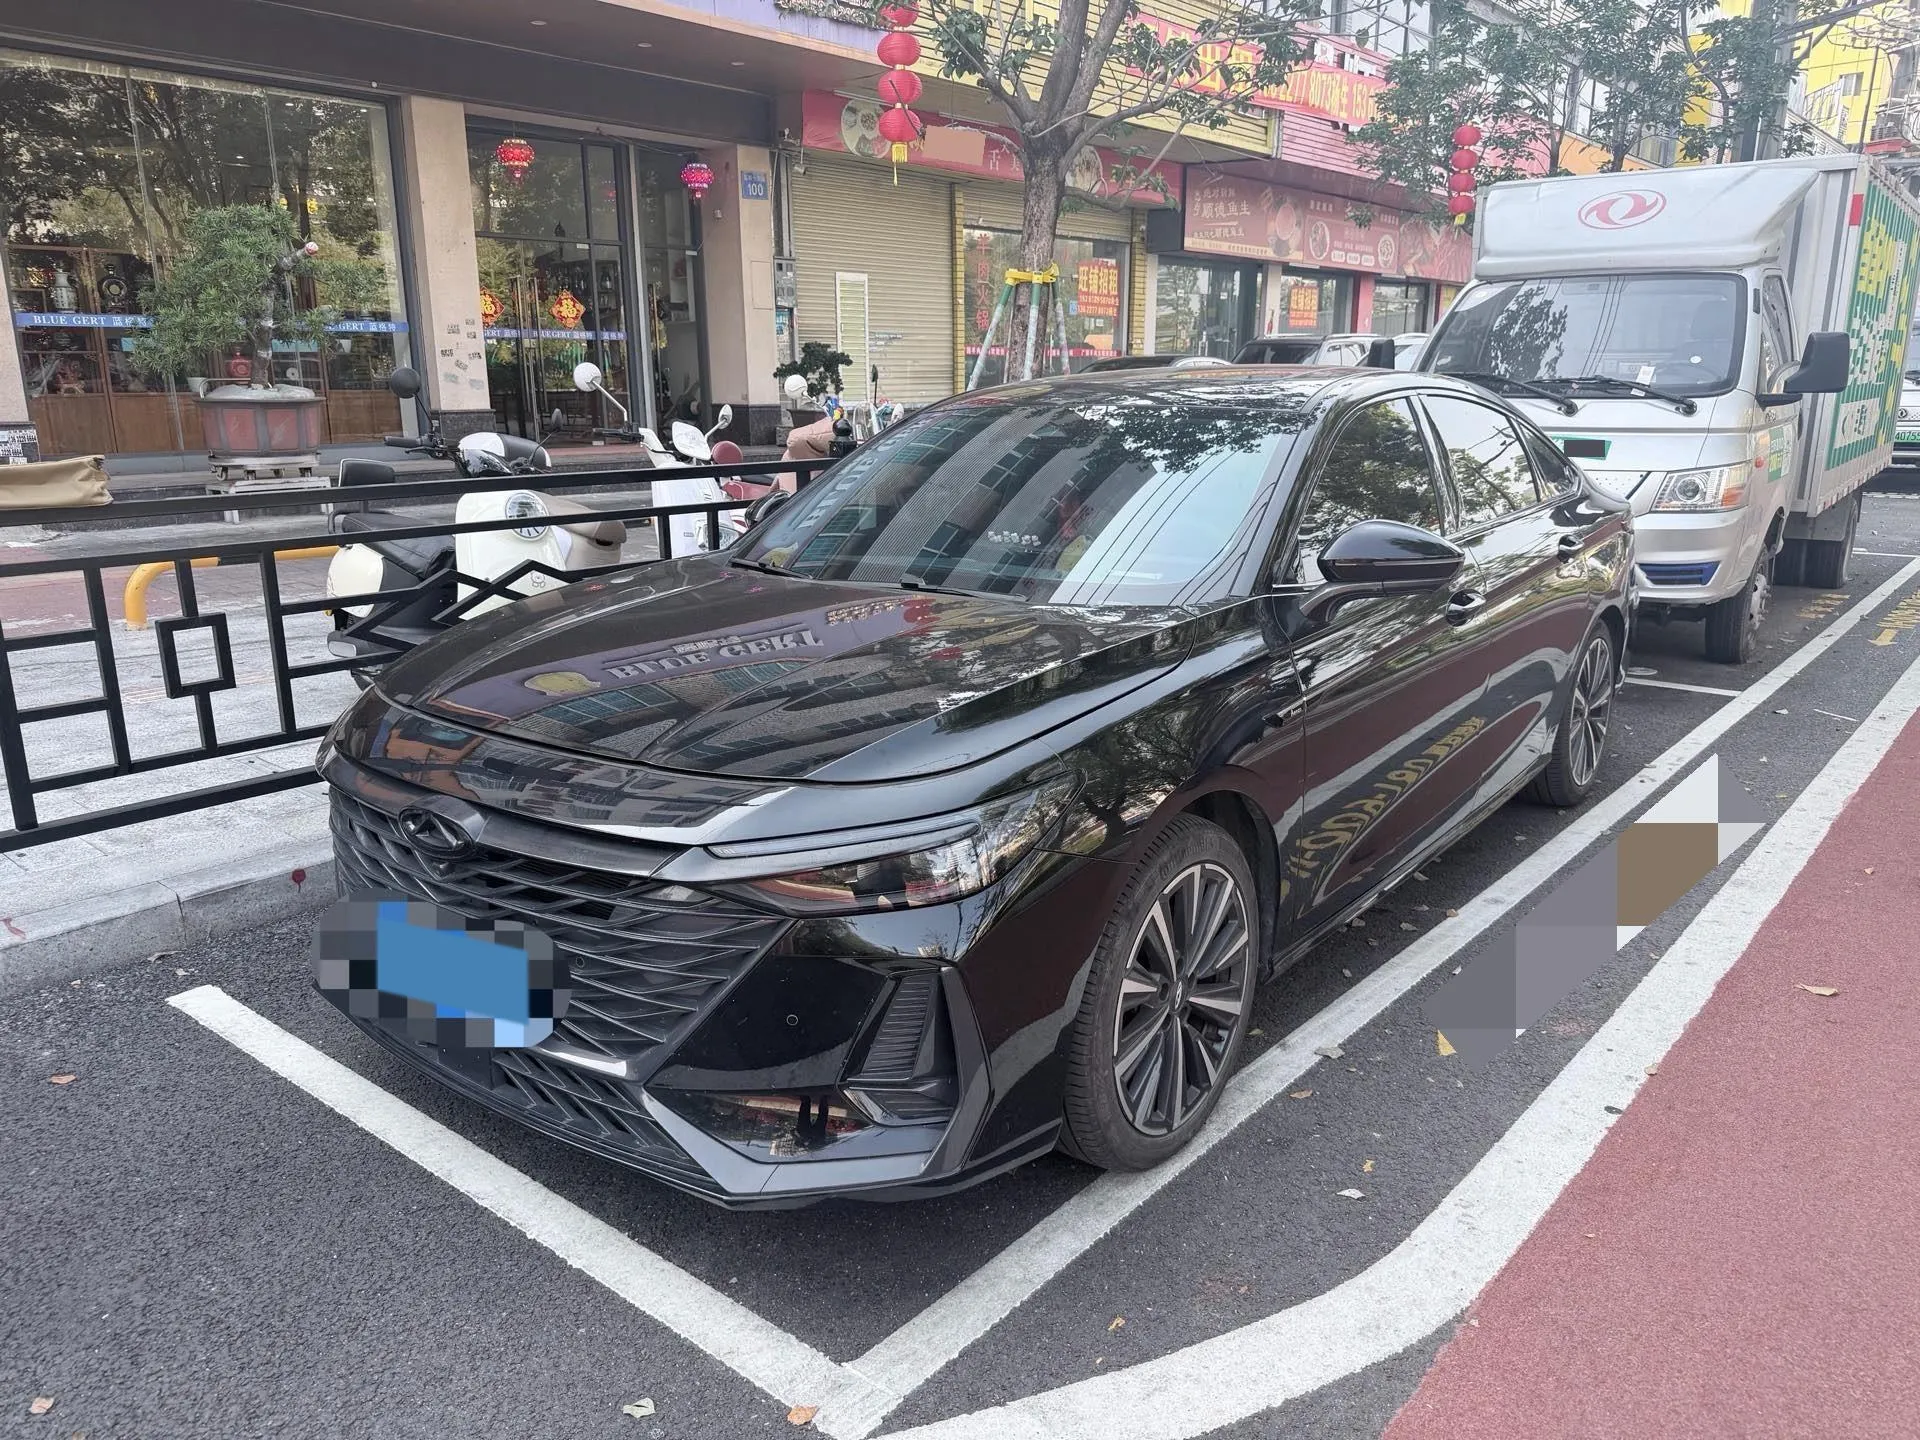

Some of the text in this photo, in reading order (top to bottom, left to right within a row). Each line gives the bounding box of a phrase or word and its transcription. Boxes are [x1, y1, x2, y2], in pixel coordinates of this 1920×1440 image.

[747, 183, 764, 196] 100
[976, 232, 992, 330] 羊肉火锅
[1078, 265, 1119, 296] 旺铺招租
[33, 315, 67, 326] BLUE
[72, 316, 106, 326] GERT
[338, 321, 365, 332] GERT
